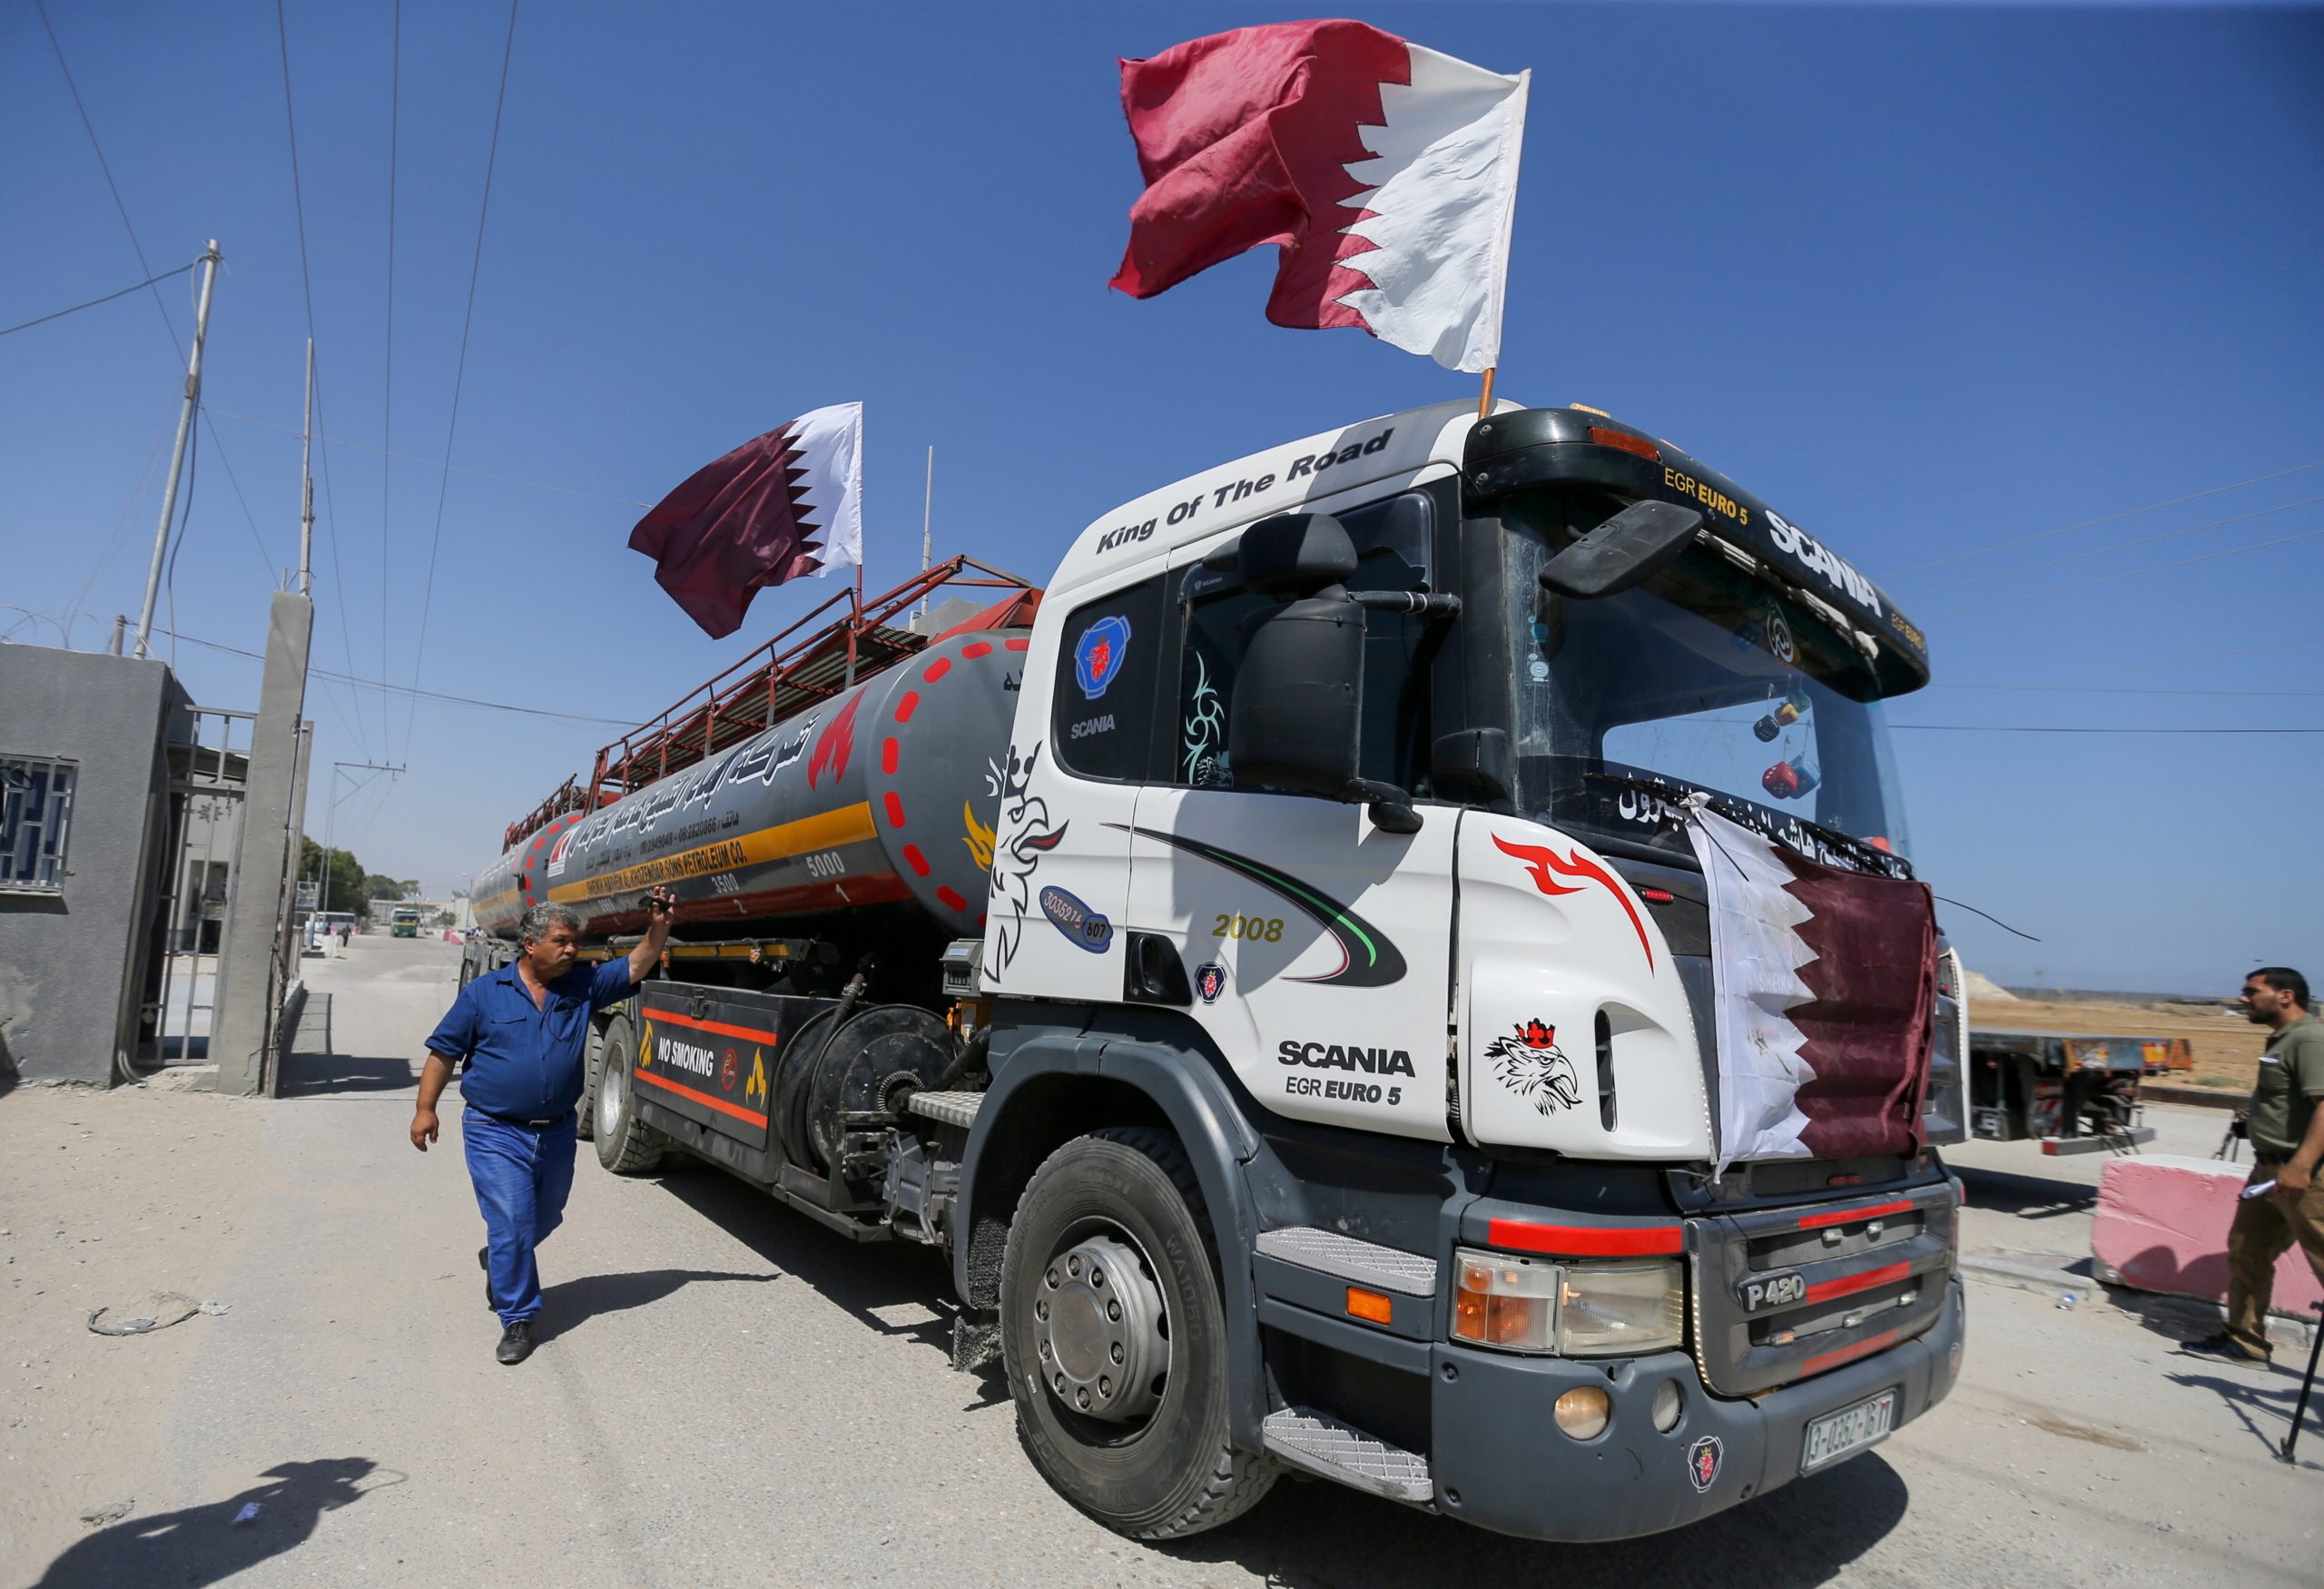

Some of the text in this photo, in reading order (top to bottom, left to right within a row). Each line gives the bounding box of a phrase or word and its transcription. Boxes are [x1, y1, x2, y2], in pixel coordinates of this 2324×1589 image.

[1096, 427, 1395, 555] King Of The Road
[1665, 468, 1748, 526] EGR EURO 5
[1765, 509, 1883, 618] SCANIA
[1070, 714, 1116, 740] SCANIA
[683, 844, 731, 875] PETROLEUM
[730, 840, 748, 864] CO.
[711, 852, 845, 893] 3500 5000
[1087, 923, 1107, 938] 607
[1212, 913, 1285, 943] 2008
[658, 1037, 714, 1077] NO SMOKING
[1277, 1040, 1416, 1078] SCANIA
[1285, 1076, 1402, 1106] EGR EURO 5
[1748, 1275, 1805, 1311] P 420
